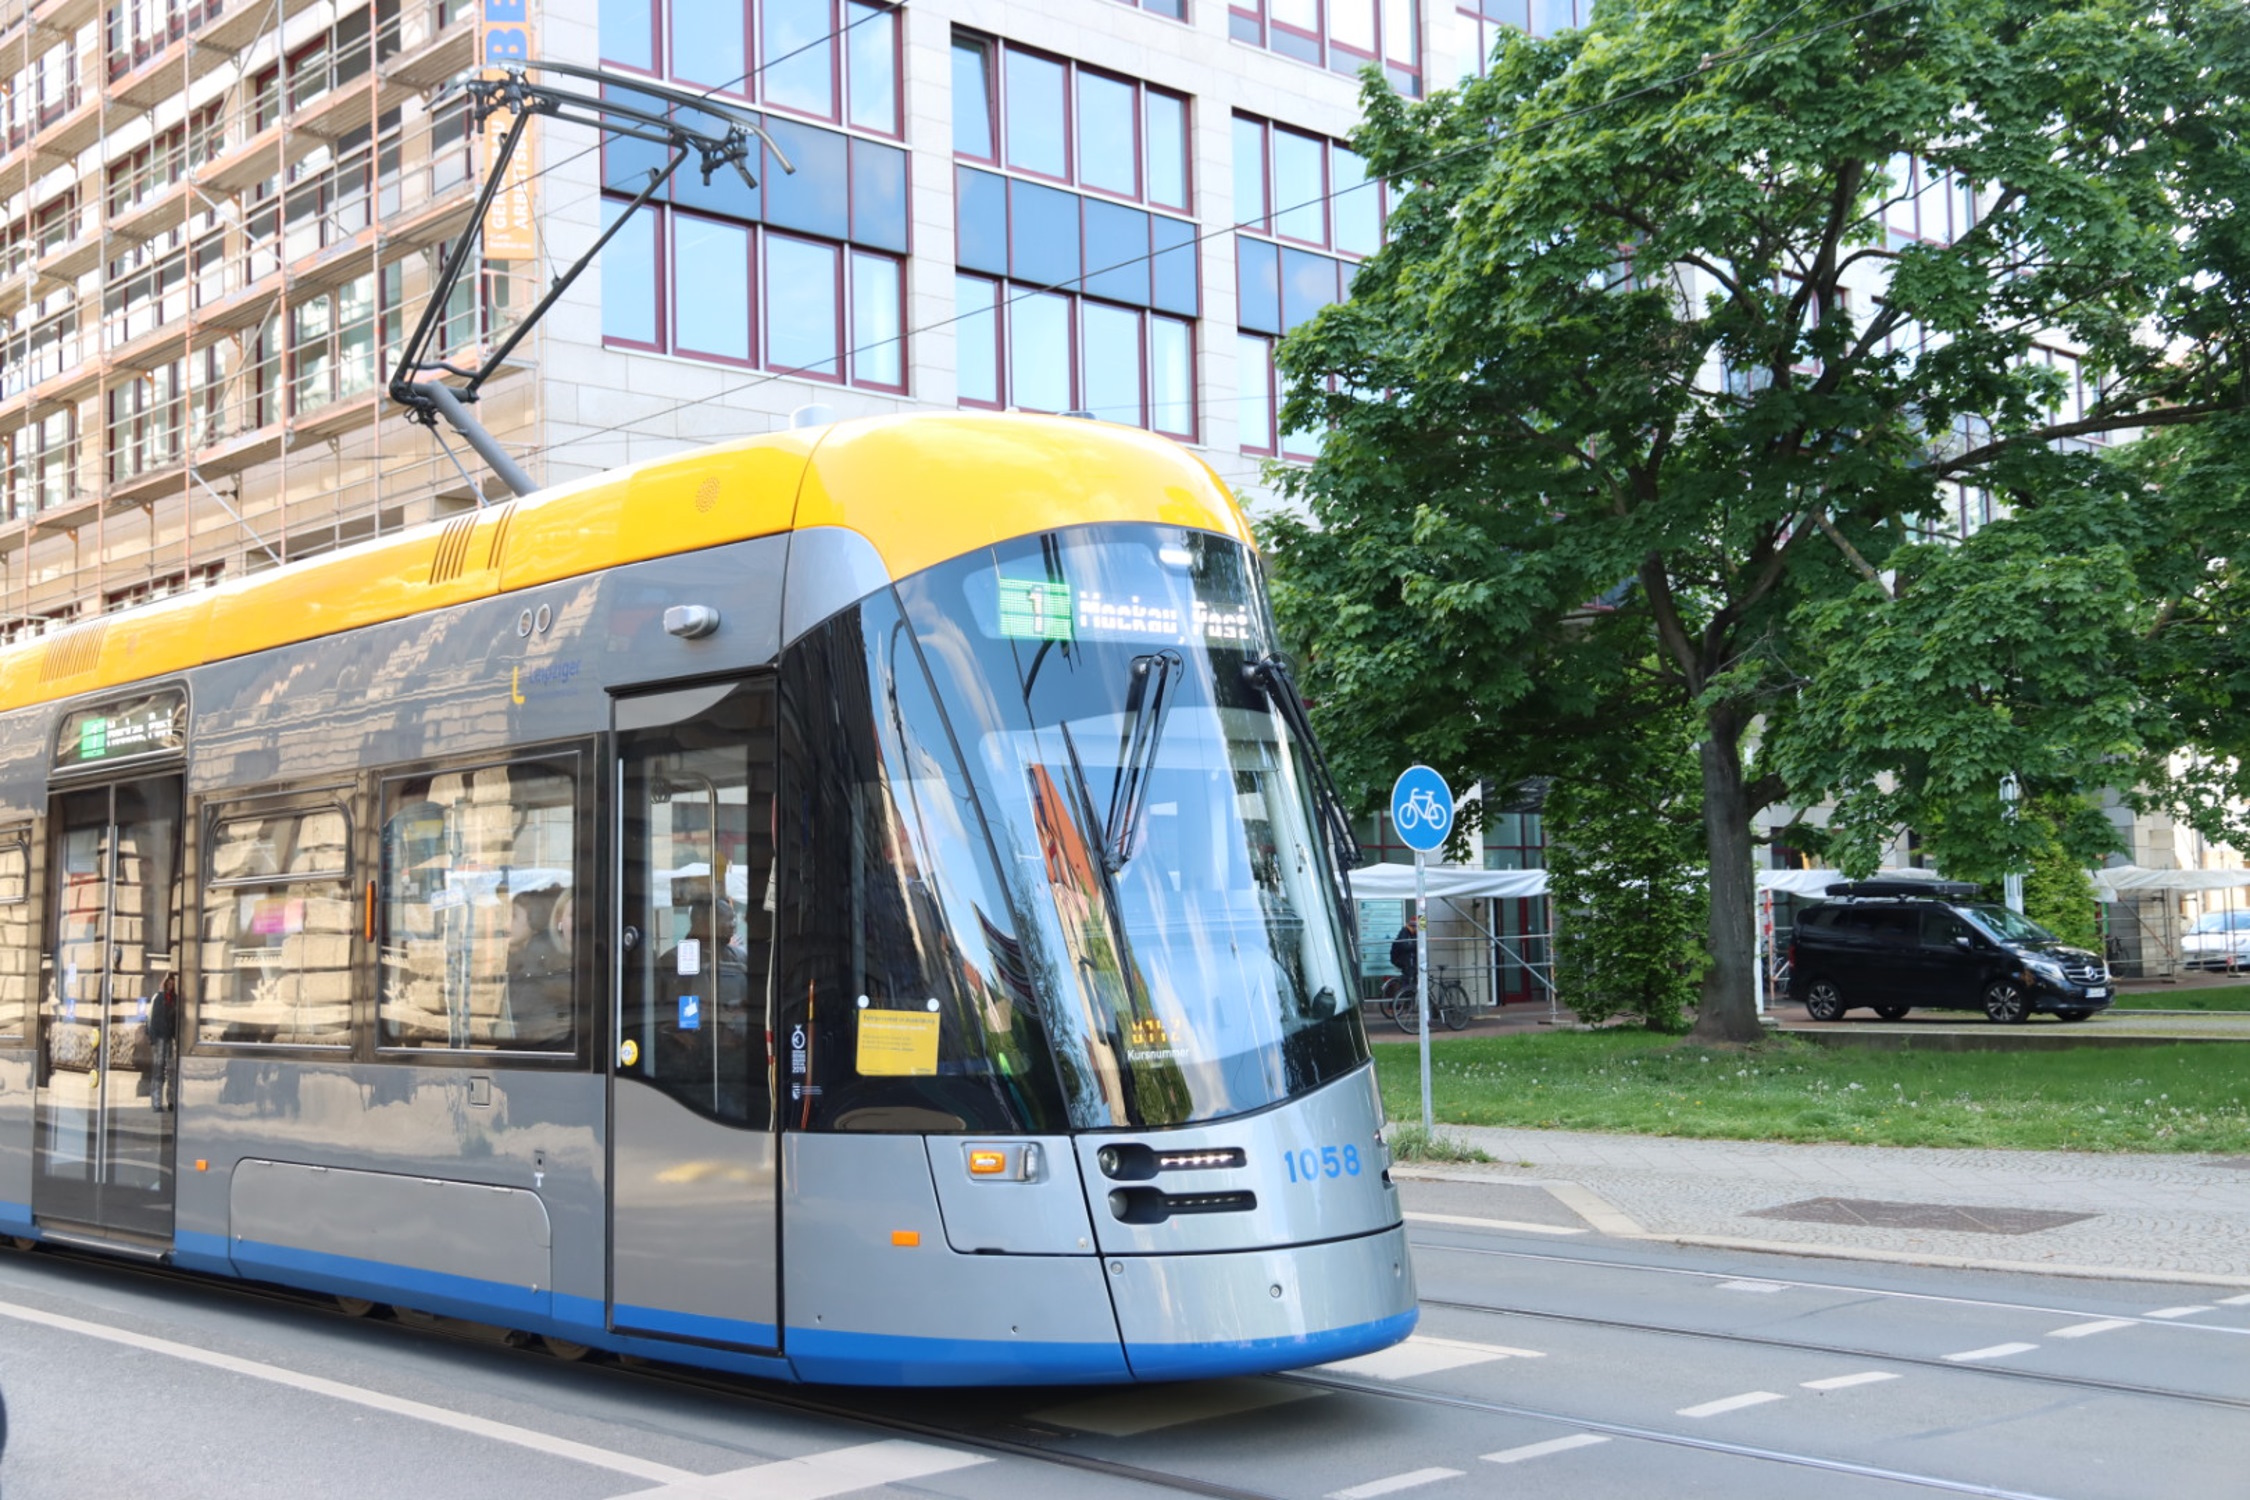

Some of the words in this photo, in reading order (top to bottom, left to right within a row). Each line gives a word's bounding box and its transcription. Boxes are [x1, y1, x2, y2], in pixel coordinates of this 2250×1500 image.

[1028, 586, 1043, 632] 1
[1127, 1048, 1189, 1062] Kursnummer
[1283, 1143, 1361, 1184] 1058
